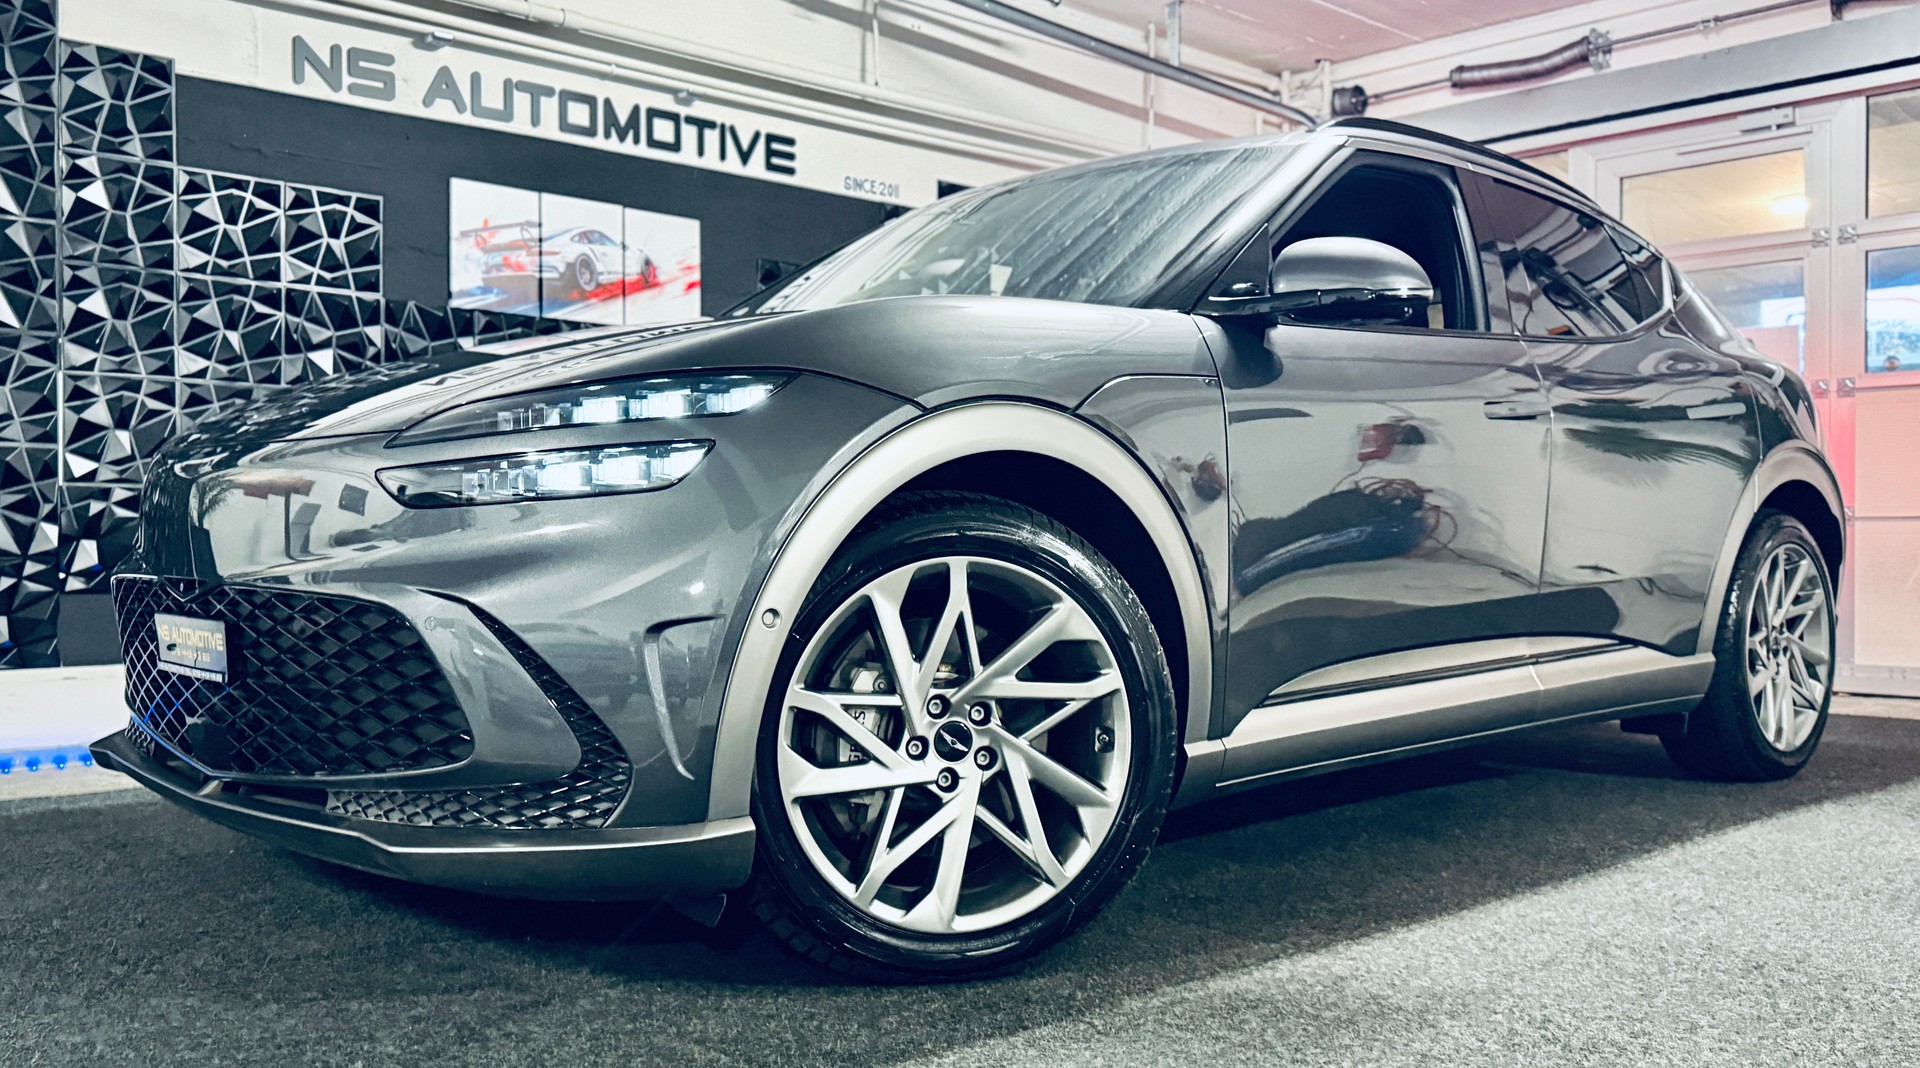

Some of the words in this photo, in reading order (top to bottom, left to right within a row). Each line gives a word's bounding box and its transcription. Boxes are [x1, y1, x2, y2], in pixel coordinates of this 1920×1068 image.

[292, 35, 396, 102] NS
[421, 65, 796, 176] AUTOMOTIVE
[171, 625, 224, 652] AUTOMOTIVE
